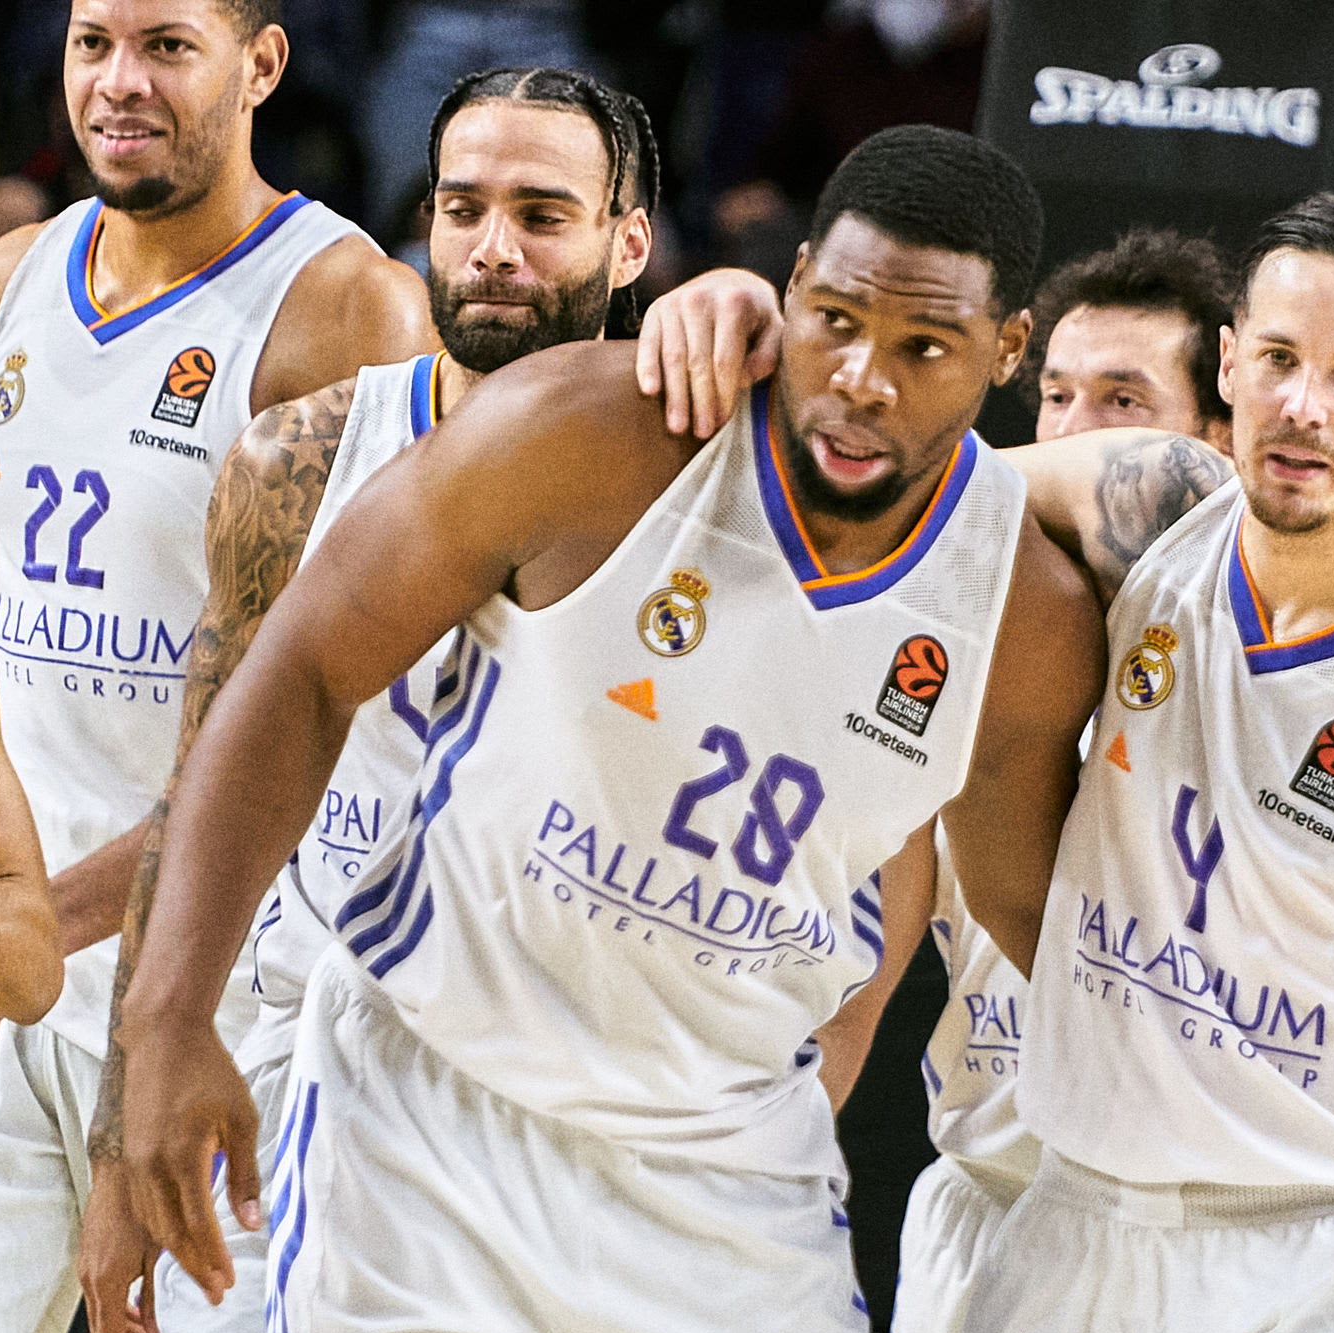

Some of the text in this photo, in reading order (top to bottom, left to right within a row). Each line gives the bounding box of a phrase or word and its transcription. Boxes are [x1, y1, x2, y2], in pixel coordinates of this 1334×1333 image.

[1029, 66, 1321, 148] SPALDING
[22, 464, 111, 590] 22
[64, 673, 169, 704] GROU
[882, 697, 925, 724] AIRLINES
[887, 687, 929, 716] TURKISH
[662, 724, 826, 887] 28
[524, 860, 655, 946] HOTEL
[538, 799, 836, 955] PALLADIUM
[1180, 1018, 1318, 1088] GROP
